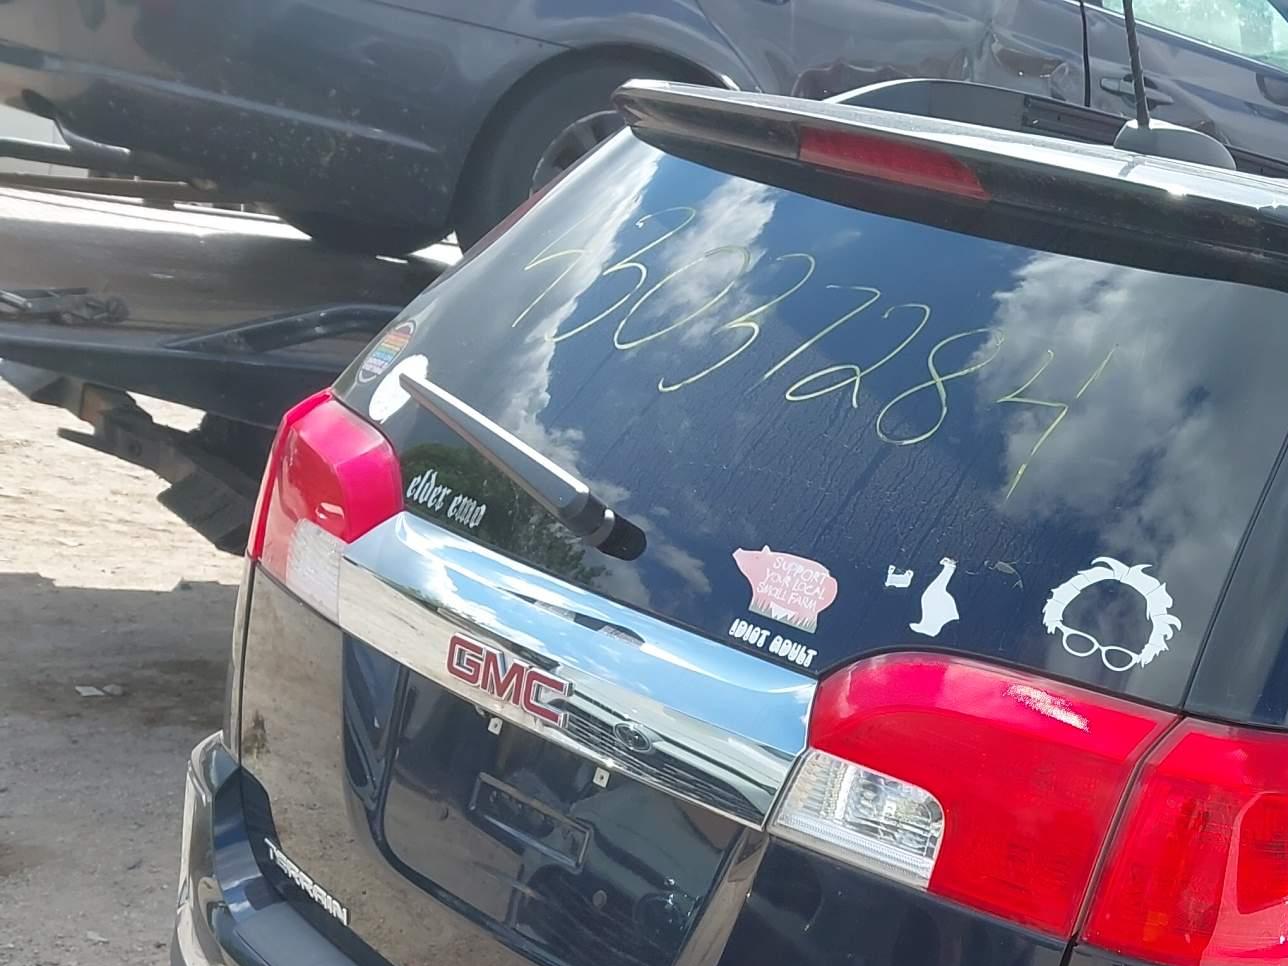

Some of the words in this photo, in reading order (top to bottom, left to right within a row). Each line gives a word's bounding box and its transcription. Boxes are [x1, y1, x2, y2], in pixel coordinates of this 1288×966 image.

[406, 468, 453, 511] elder
[773, 556, 827, 585] SUPPORT
[791, 578, 826, 600] LOCAL
[787, 592, 817, 613] FARM
[728, 618, 771, 648] IDIOT
[768, 634, 818, 668] ADULT
[446, 632, 575, 728] GMC
[264, 837, 350, 926] TERRAIN
